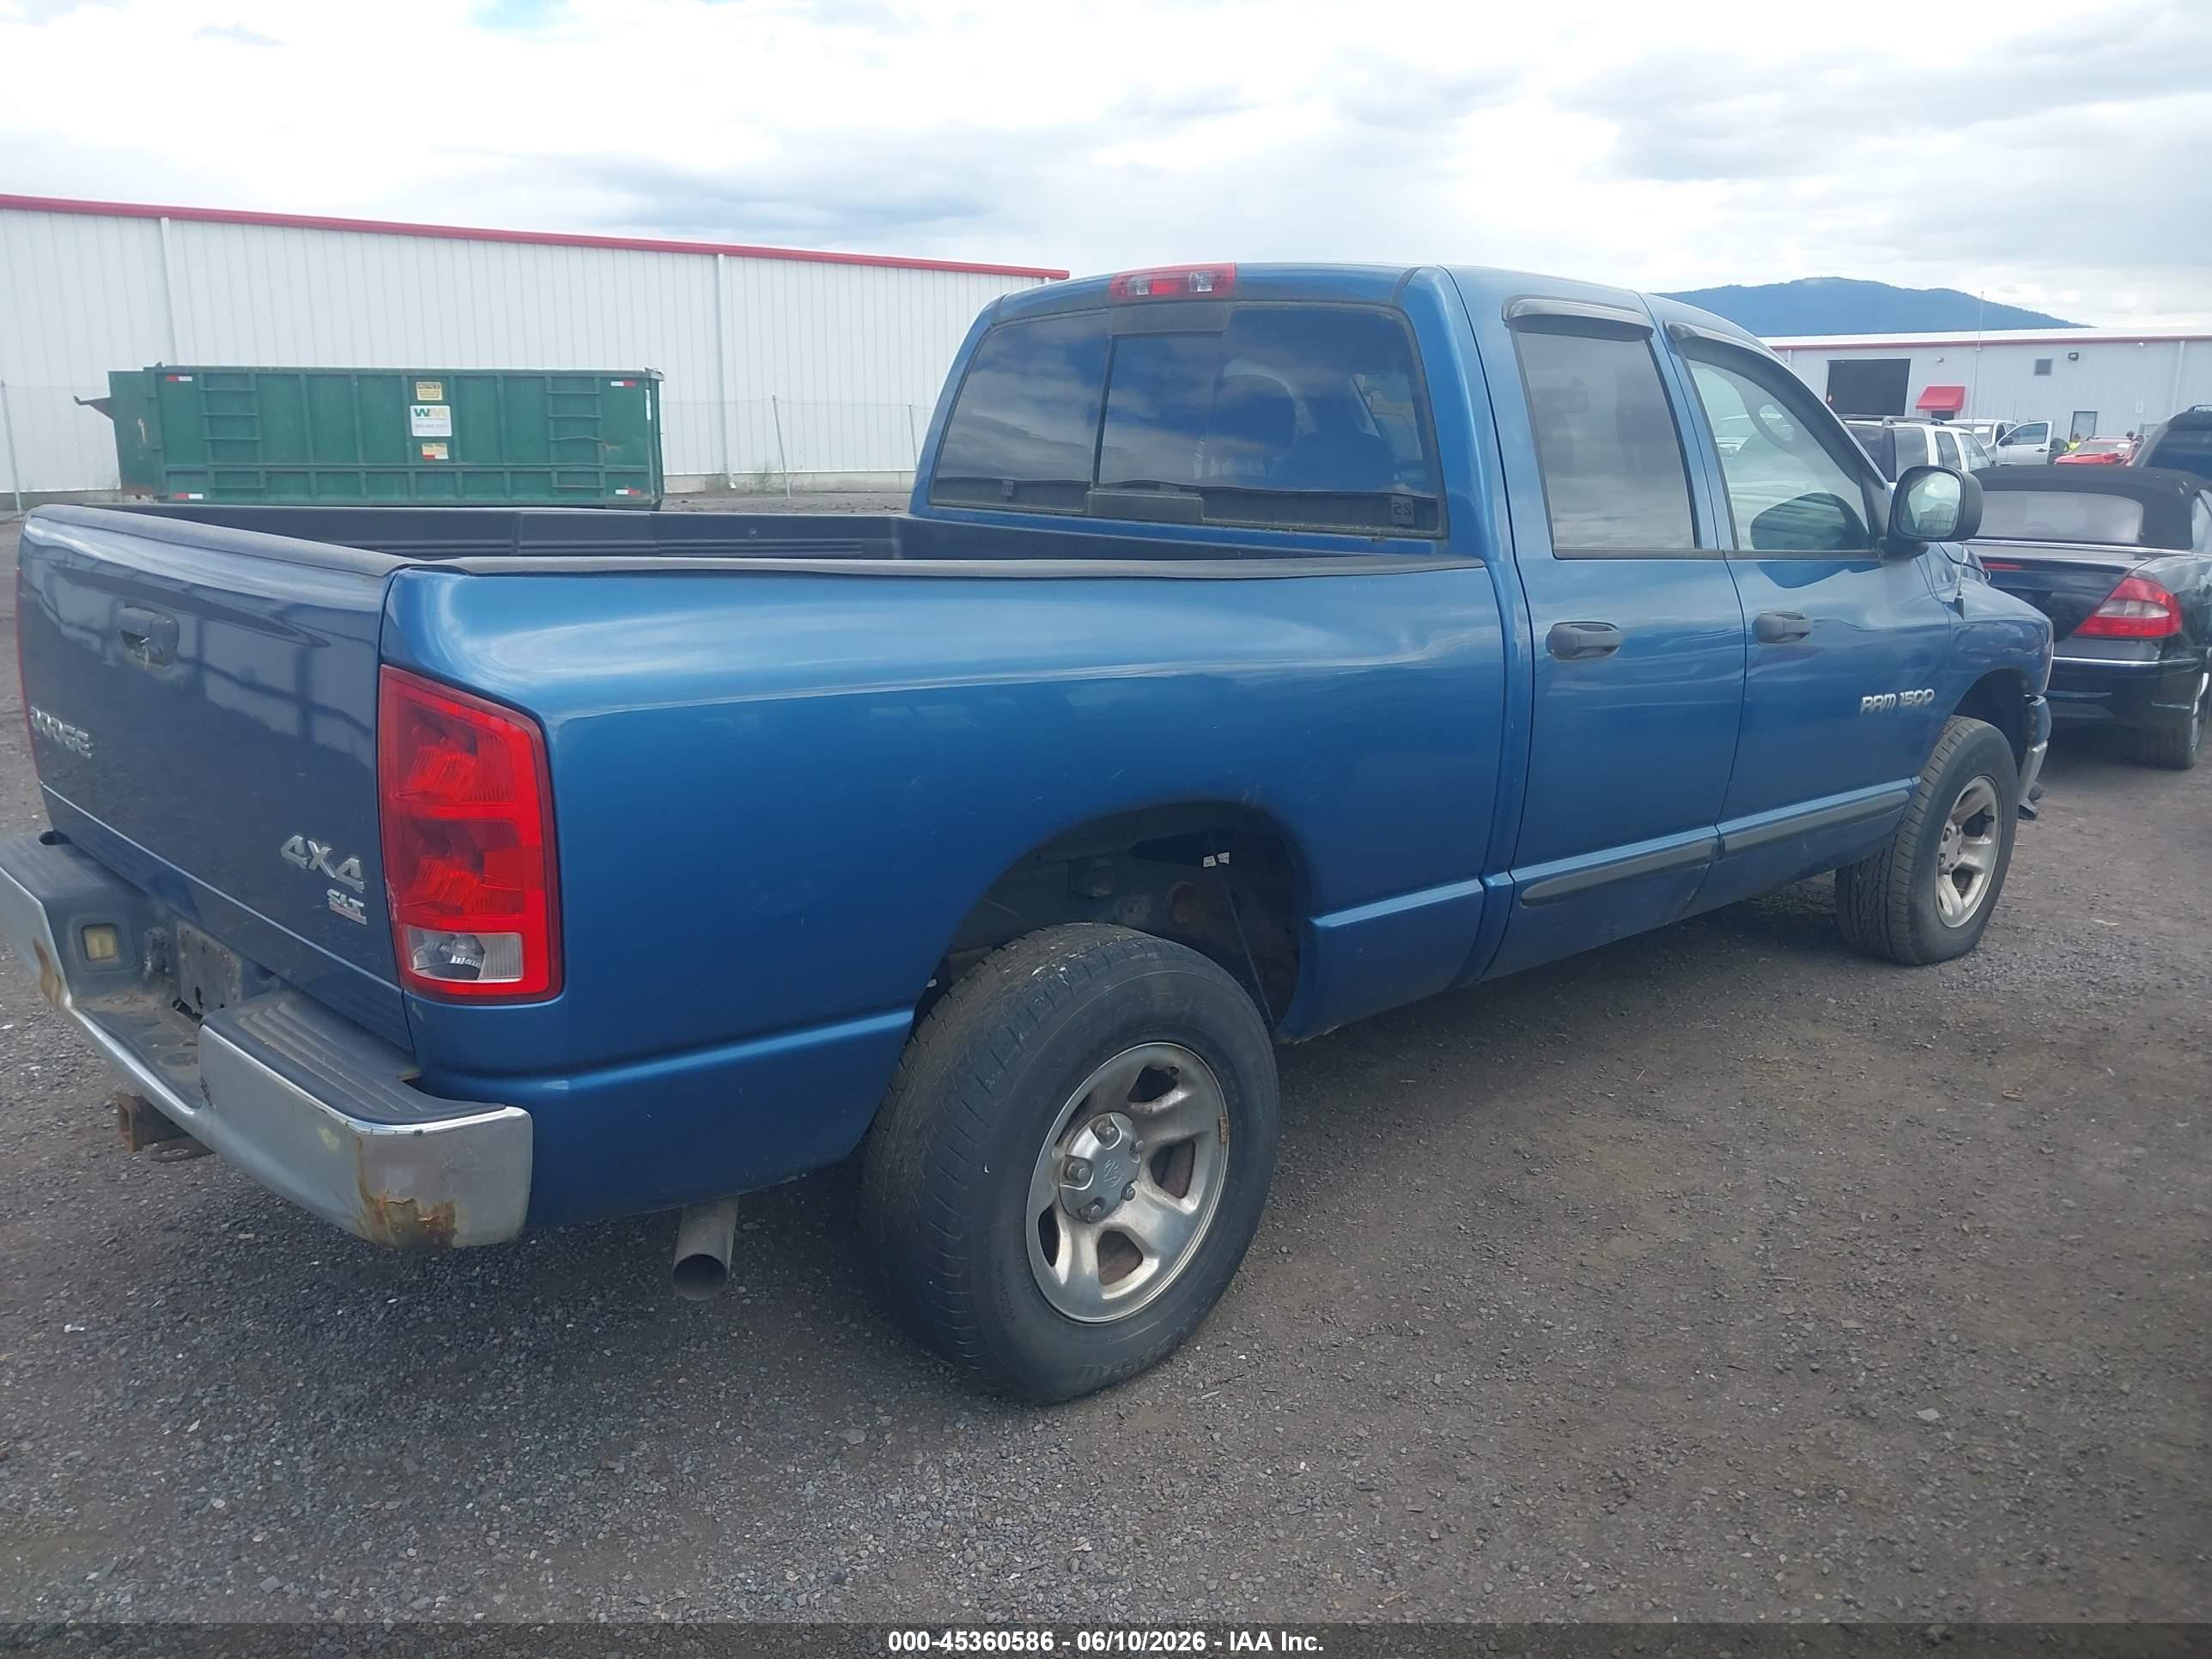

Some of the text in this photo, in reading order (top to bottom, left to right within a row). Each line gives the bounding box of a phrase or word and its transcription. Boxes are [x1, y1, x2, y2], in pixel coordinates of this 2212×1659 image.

[1860, 688, 1936, 714] RAM 1500
[326, 888, 365, 916] SLT
